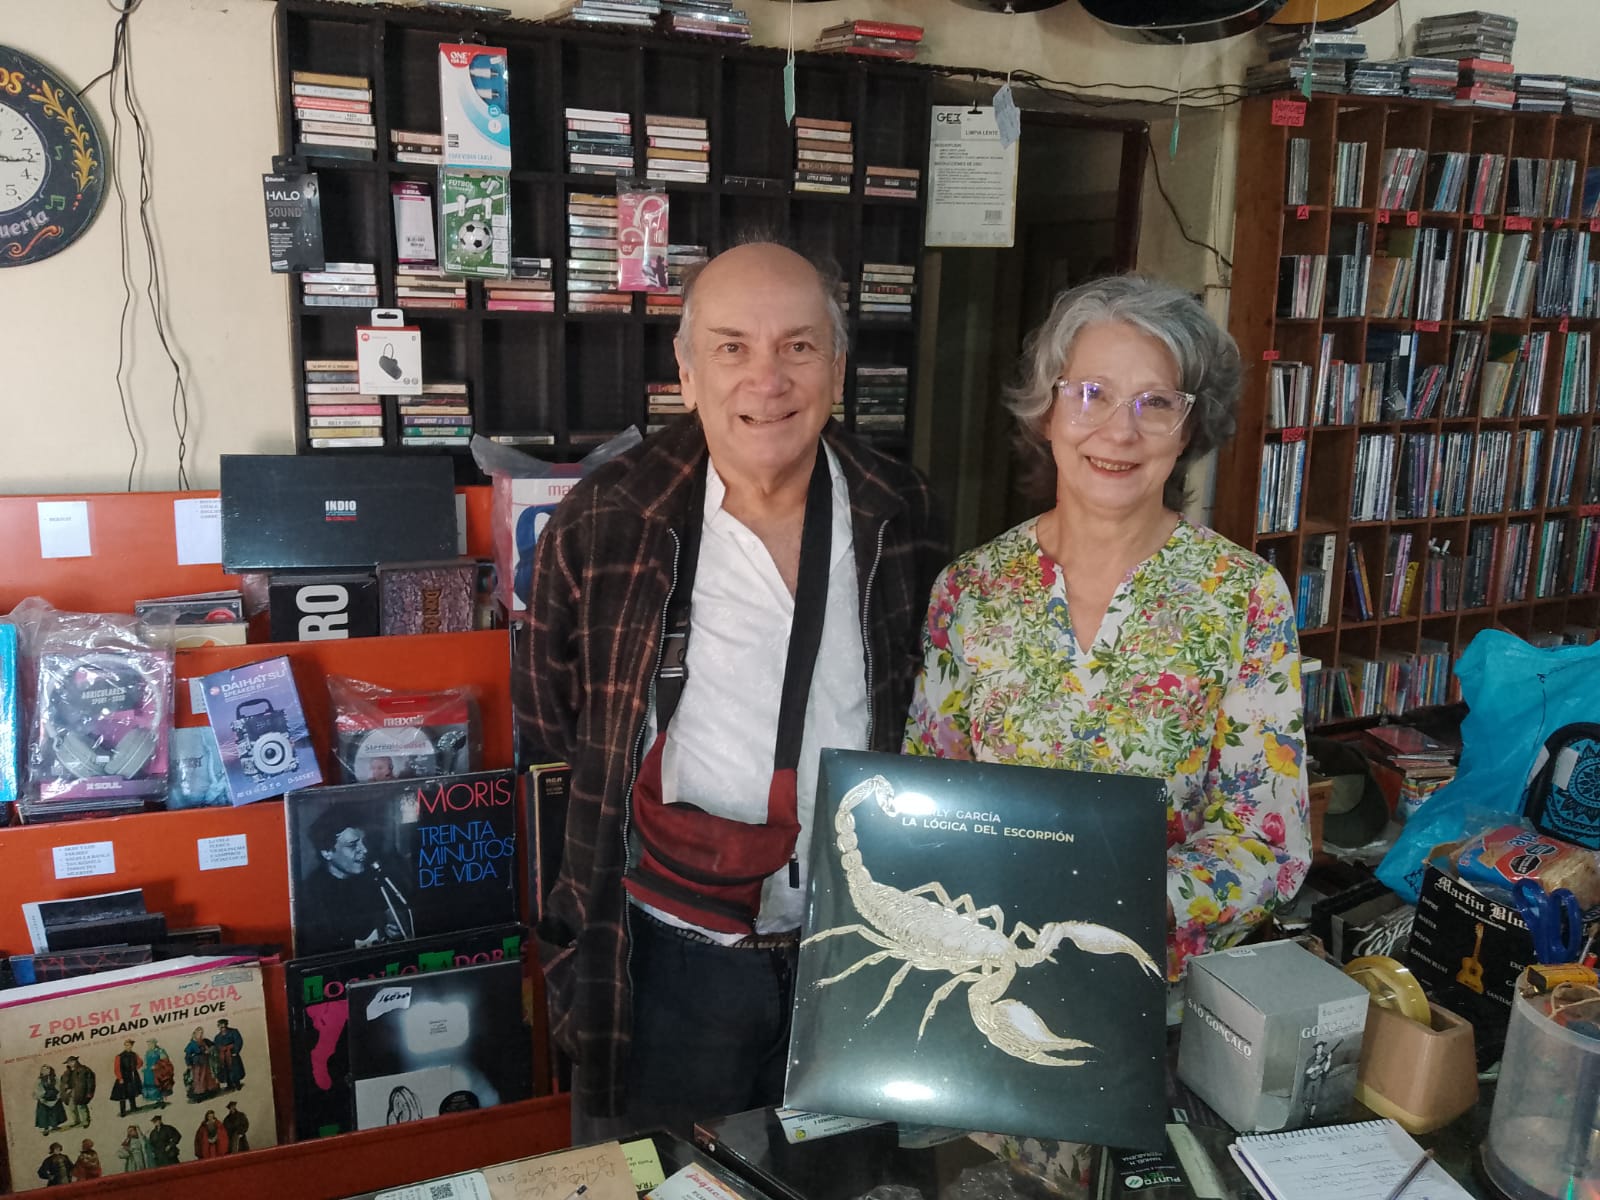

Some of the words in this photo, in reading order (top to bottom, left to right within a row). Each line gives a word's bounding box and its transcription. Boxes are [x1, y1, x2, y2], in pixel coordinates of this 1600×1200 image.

[450, 51, 468, 59] ONE
[20, 168, 31, 180] 4
[5, 184, 18, 196] 5
[266, 190, 300, 201] HALO
[268, 207, 302, 218] SOUND
[325, 500, 357, 511] INDIO
[221, 669, 287, 692] DAIHATSU
[416, 779, 511, 816] MORIS
[956, 810, 1001, 823] GARCÍA
[417, 820, 496, 847] TREINTA
[902, 817, 917, 827] LA
[923, 818, 967, 832] LÓGICA
[974, 825, 998, 836] DEL
[1004, 827, 1074, 843] ESCORPIÓN
[419, 836, 515, 868] MINUTOS
[419, 867, 445, 889] DE
[453, 862, 498, 884] VIDA
[1434, 876, 1485, 913] Martin
[29, 1023, 43, 1039] Z
[49, 1008, 120, 1036] POLSKI
[130, 1003, 142, 1017] Z
[150, 983, 242, 1012] MIŁOŚCIĄ
[44, 1029, 85, 1049] FROM
[90, 1017, 149, 1038] POLAND
[153, 1008, 189, 1026] WITH
[193, 1001, 226, 1017] LOVE
